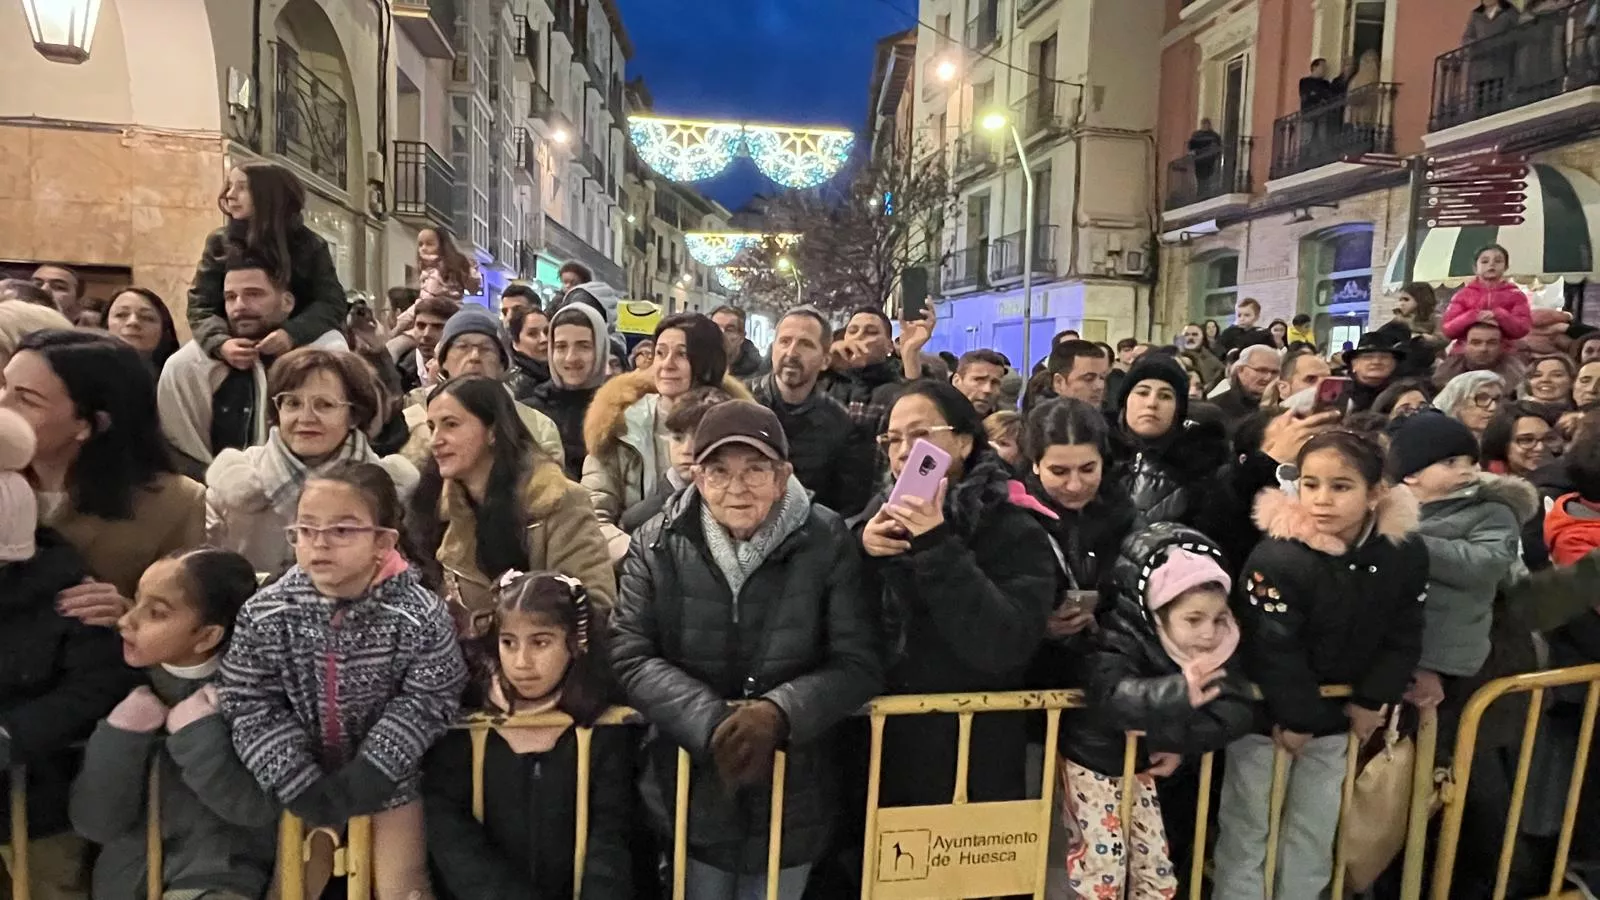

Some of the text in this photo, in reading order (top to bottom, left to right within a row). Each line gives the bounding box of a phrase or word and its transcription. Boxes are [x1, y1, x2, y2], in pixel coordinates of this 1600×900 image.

[933, 831, 1038, 852] Ayuntamiento
[931, 850, 1017, 867] de Huesca
